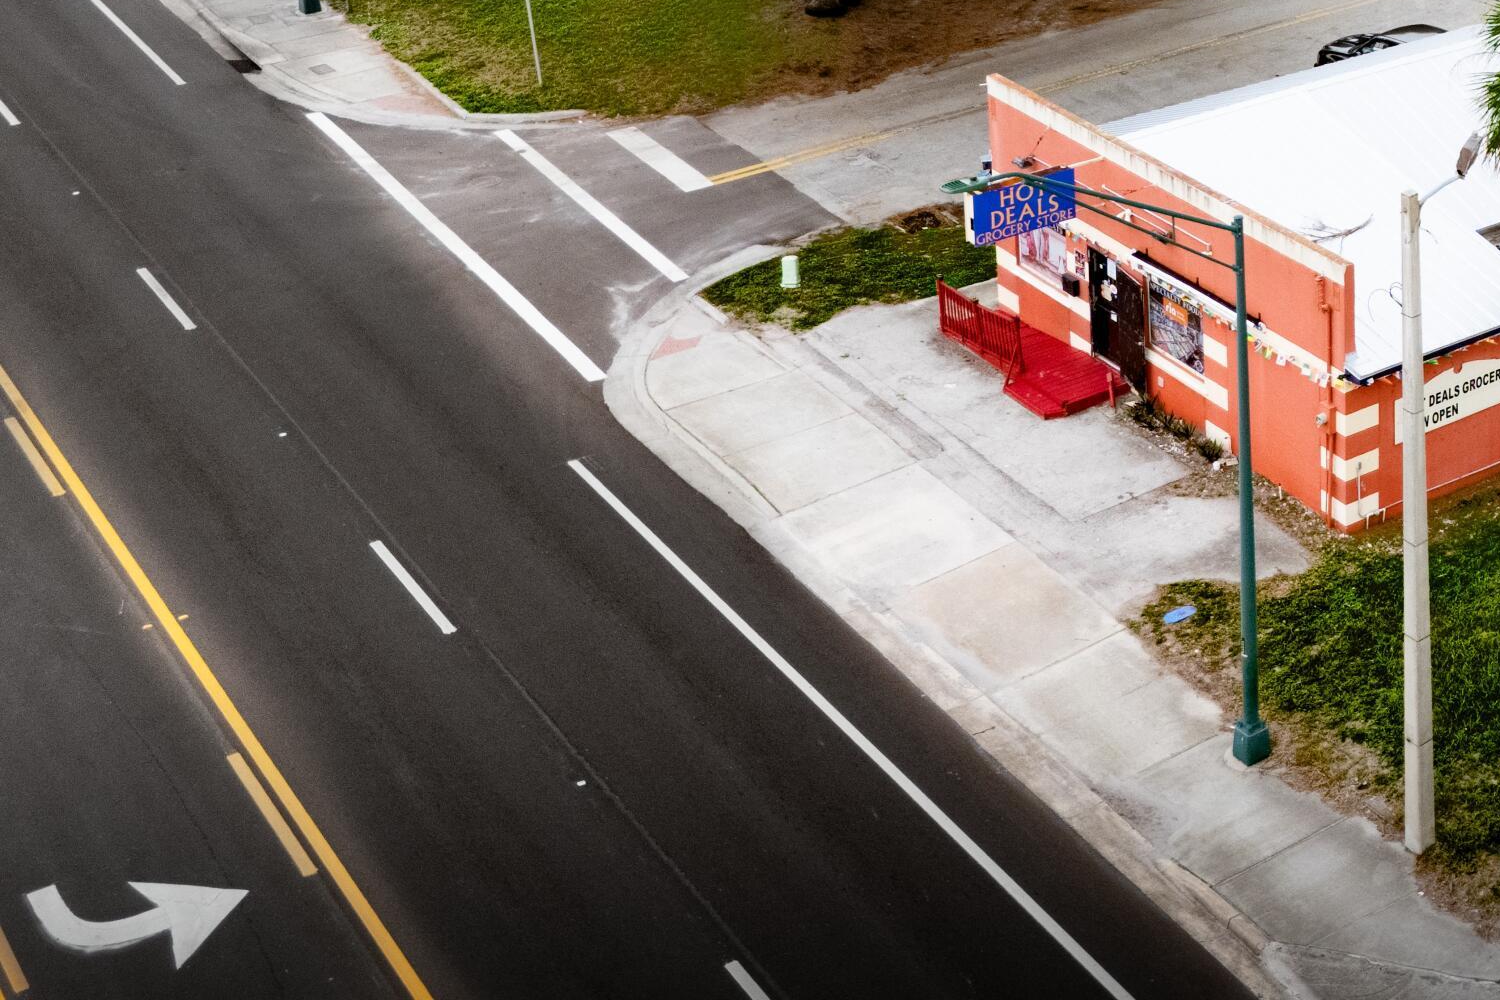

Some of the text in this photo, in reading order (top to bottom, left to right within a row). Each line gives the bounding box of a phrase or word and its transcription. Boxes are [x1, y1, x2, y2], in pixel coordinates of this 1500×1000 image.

[1000, 183, 1046, 208] HO
[990, 194, 1059, 230] DEALS
[976, 220, 1030, 245] GROCERY
[1036, 208, 1073, 228] STORE
[1429, 385, 1460, 408] DEALS
[1432, 403, 1459, 424] OPEN
